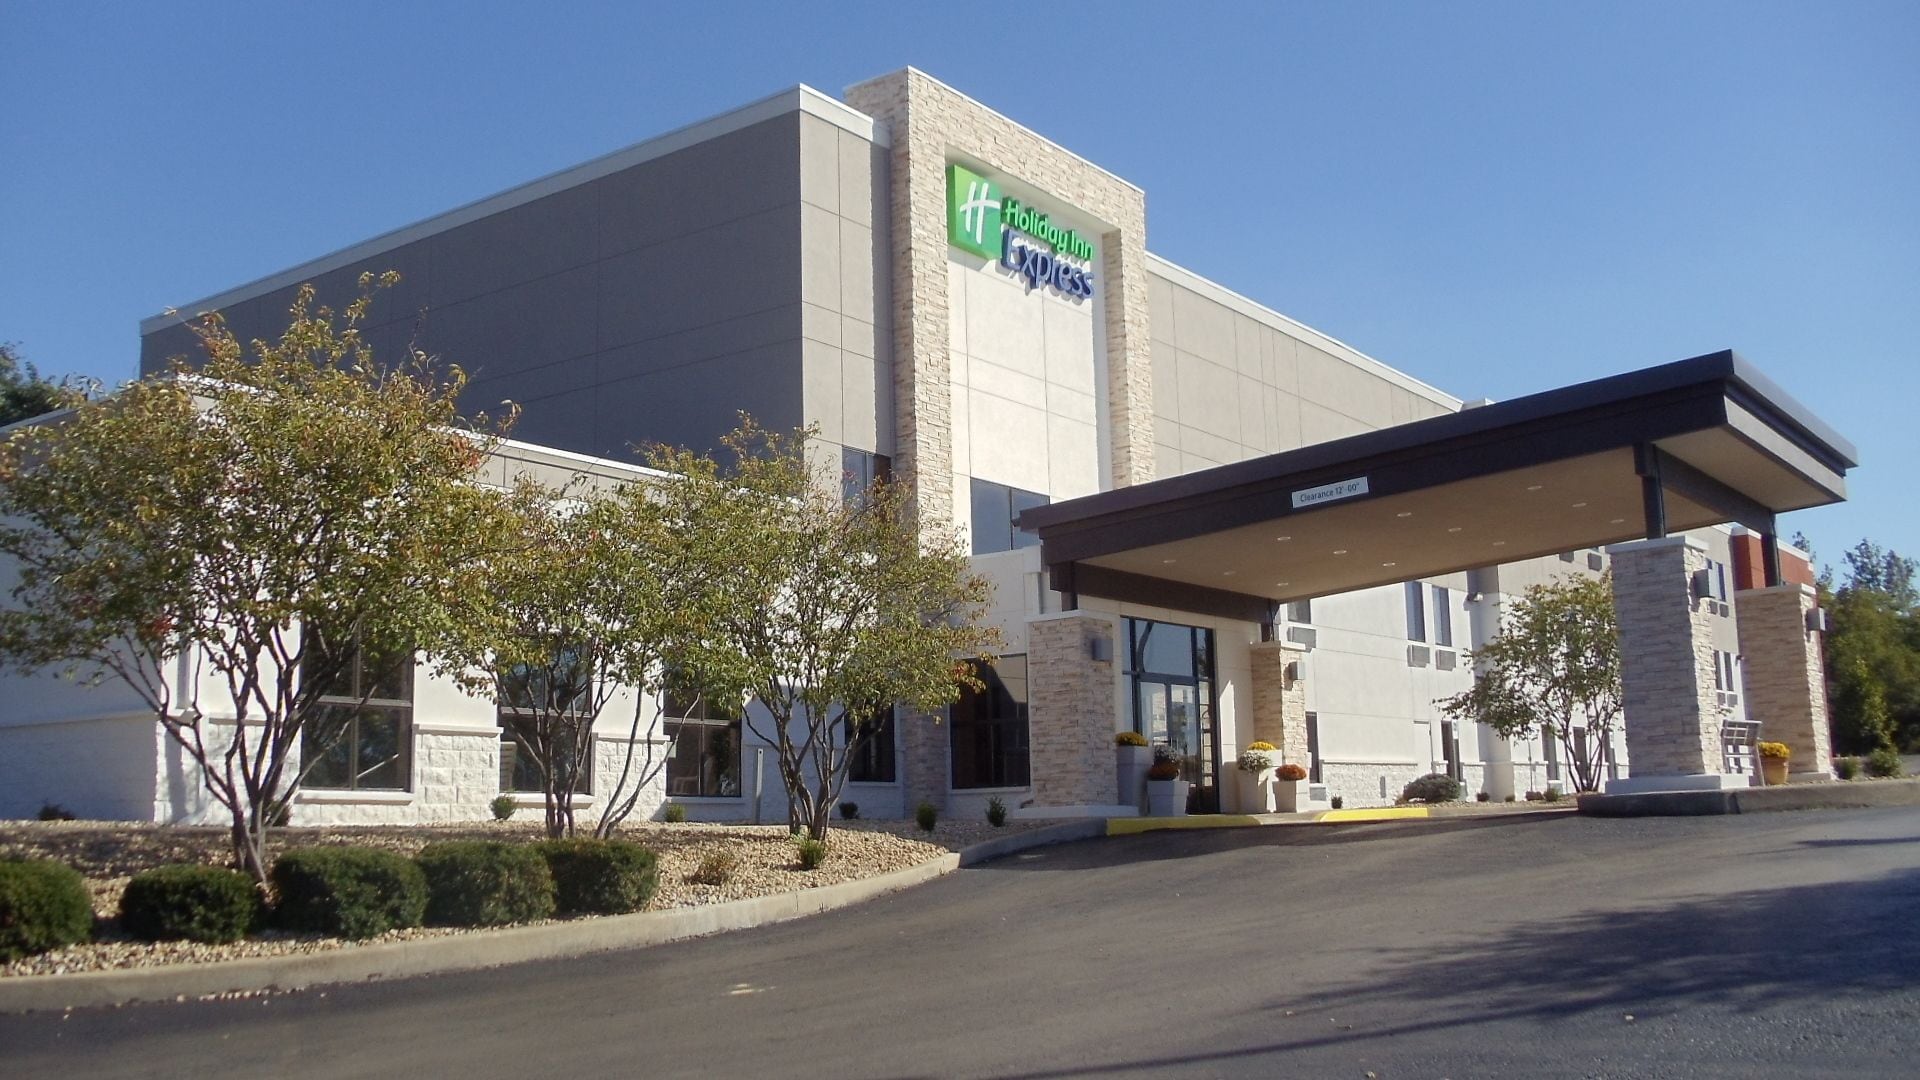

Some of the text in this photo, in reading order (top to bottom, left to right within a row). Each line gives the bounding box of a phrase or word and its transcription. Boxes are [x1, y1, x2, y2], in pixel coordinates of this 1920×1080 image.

[1002, 198, 1094, 261] Holiday Inn
[1002, 229, 1094, 299] Express
[1300, 489, 1334, 502] Clearance
